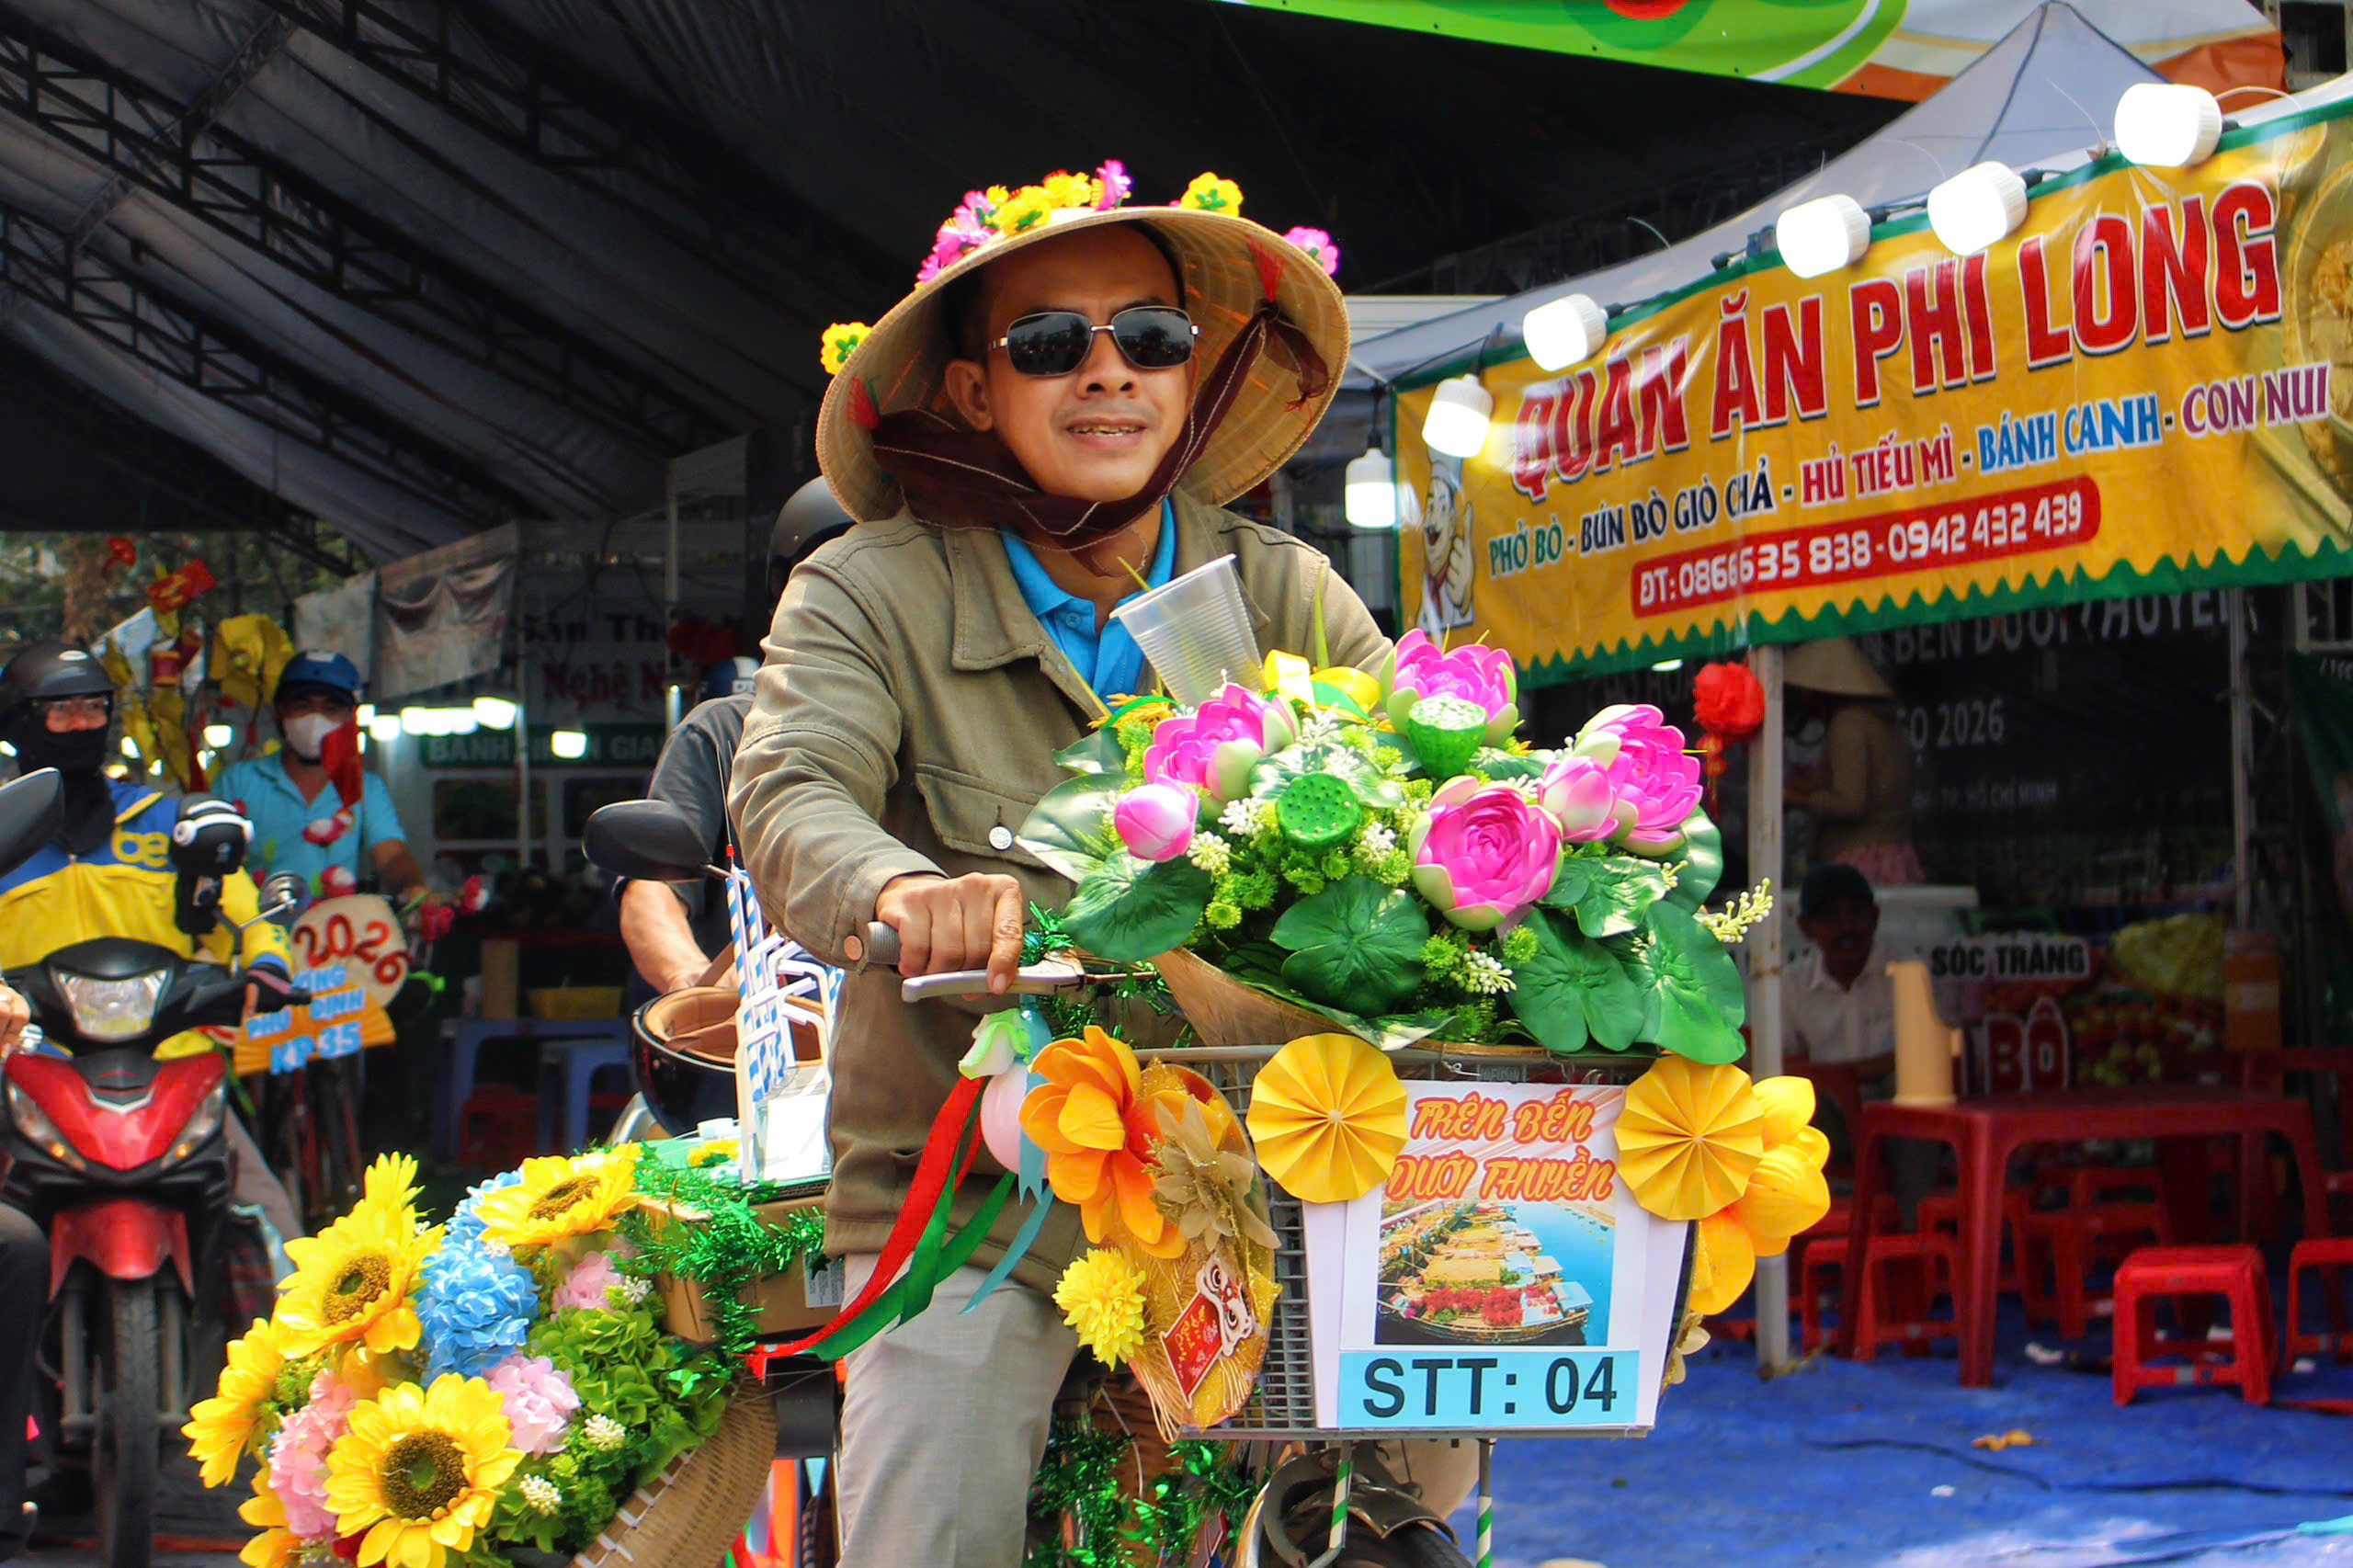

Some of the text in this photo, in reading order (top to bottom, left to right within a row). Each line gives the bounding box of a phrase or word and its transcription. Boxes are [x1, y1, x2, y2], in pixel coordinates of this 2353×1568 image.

[1512, 180, 2281, 504] QUÁN ĂN PHI LONG
[1489, 519, 1528, 578] PHỞ
[1534, 515, 1563, 566] BÒ
[1581, 496, 1624, 551] BÚN
[1632, 490, 1666, 540] BÒ
[1675, 478, 1717, 530] GIÒ
[1725, 456, 1774, 517] CHẢ
[1802, 445, 1844, 505] HỦ
[1852, 431, 1914, 494] TIẾU
[1921, 425, 1954, 483] MÌ
[1978, 410, 2055, 471] BÁNH
[2063, 394, 2160, 454] CANH
[2183, 380, 2256, 437] CON
[2264, 364, 2331, 423] NUI
[1972, 502, 2027, 548] 432
[2033, 490, 2083, 535] 439
[1936, 696, 2006, 749] 2026
[293, 912, 414, 984] 2026
[1931, 939, 1984, 976] SÓC
[1411, 1087, 1596, 1143] TRÊN BẾN
[1385, 1145, 1617, 1201] DƯỚI THUYỀN
[1362, 1356, 1618, 1417] STT: 04
